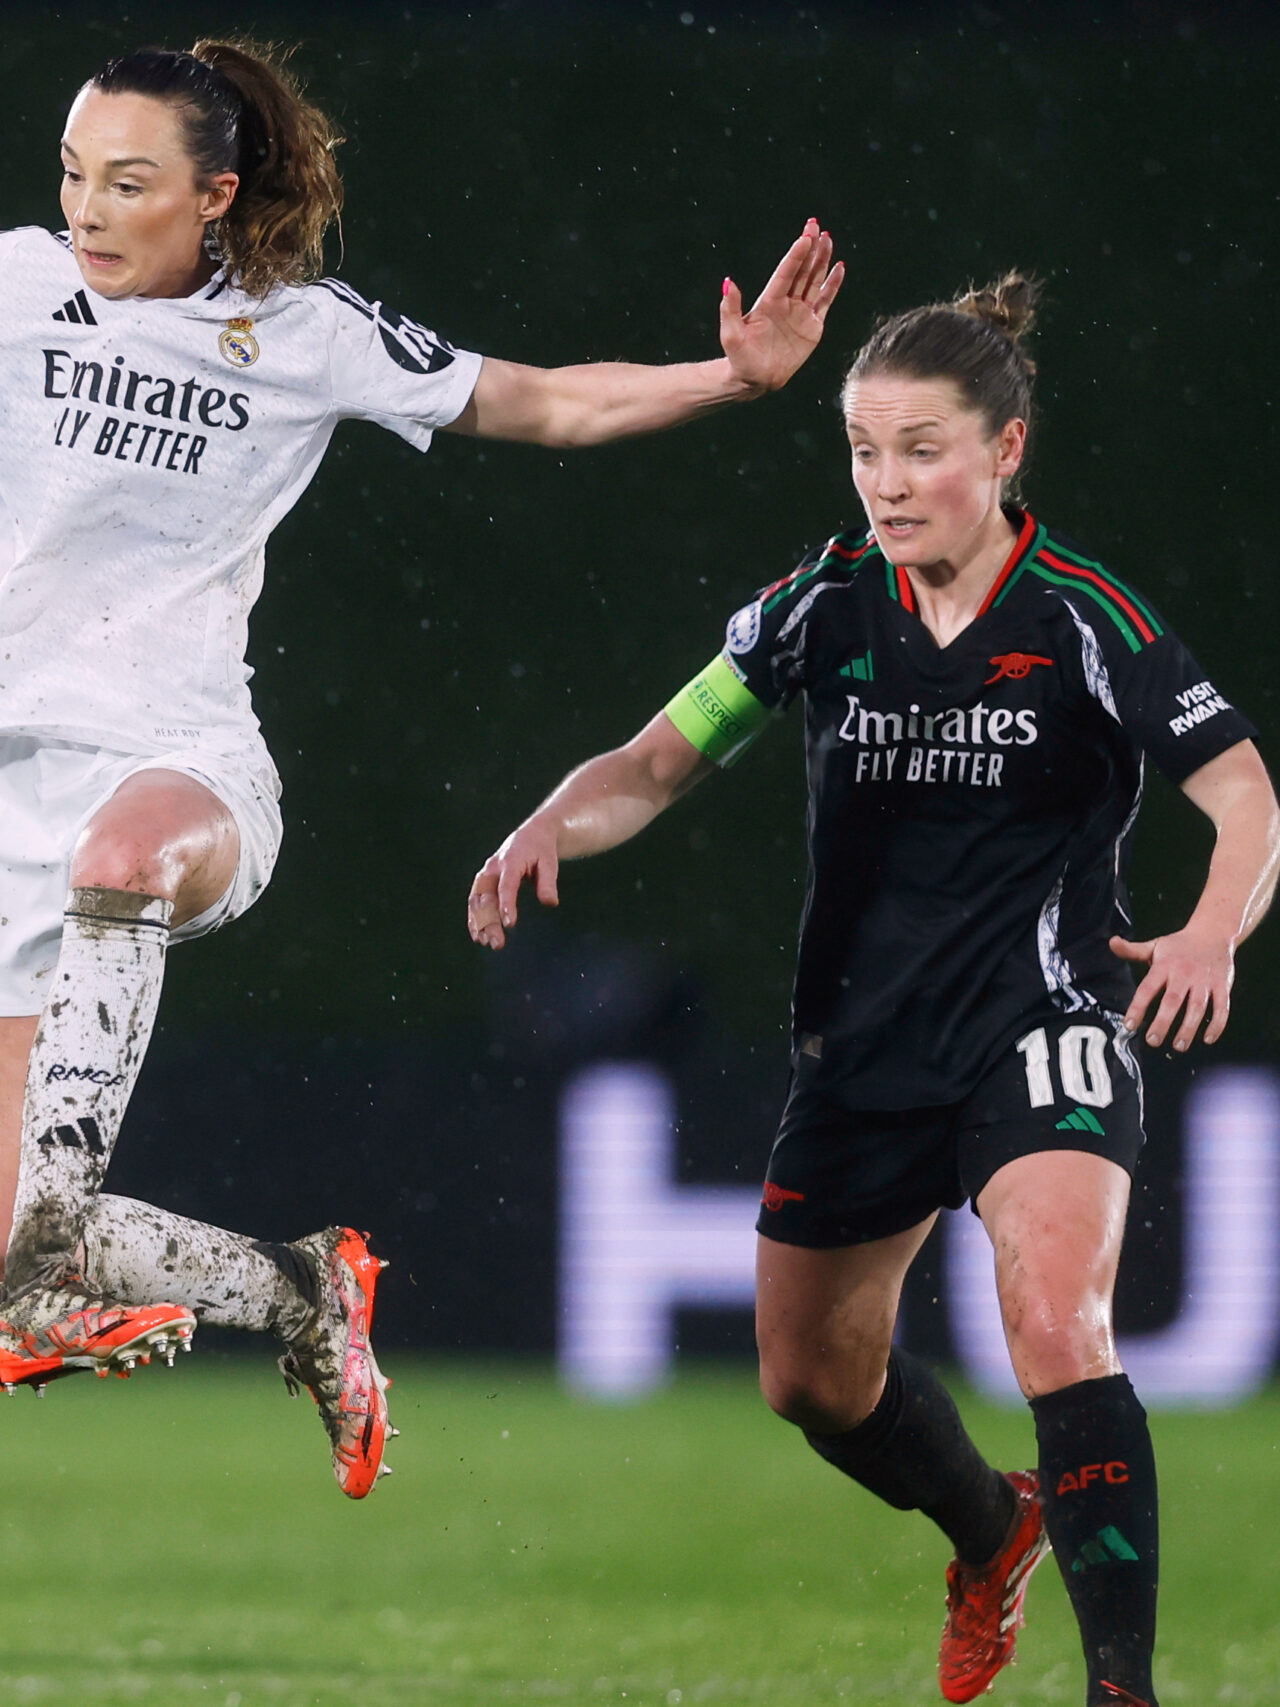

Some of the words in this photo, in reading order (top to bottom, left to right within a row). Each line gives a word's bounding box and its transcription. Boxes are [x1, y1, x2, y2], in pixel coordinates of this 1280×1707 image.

[41, 348, 251, 431] Emirates
[54, 407, 92, 449] LY
[93, 416, 208, 475] BETTER
[1168, 694, 1234, 737] RWAN
[1175, 681, 1218, 709] VISIT
[838, 695, 1039, 746] Emirates
[855, 747, 899, 783] FLY
[906, 747, 1005, 788] BETTER
[1014, 1025, 1114, 1109] 10
[1056, 1461, 1130, 1497] AFC
